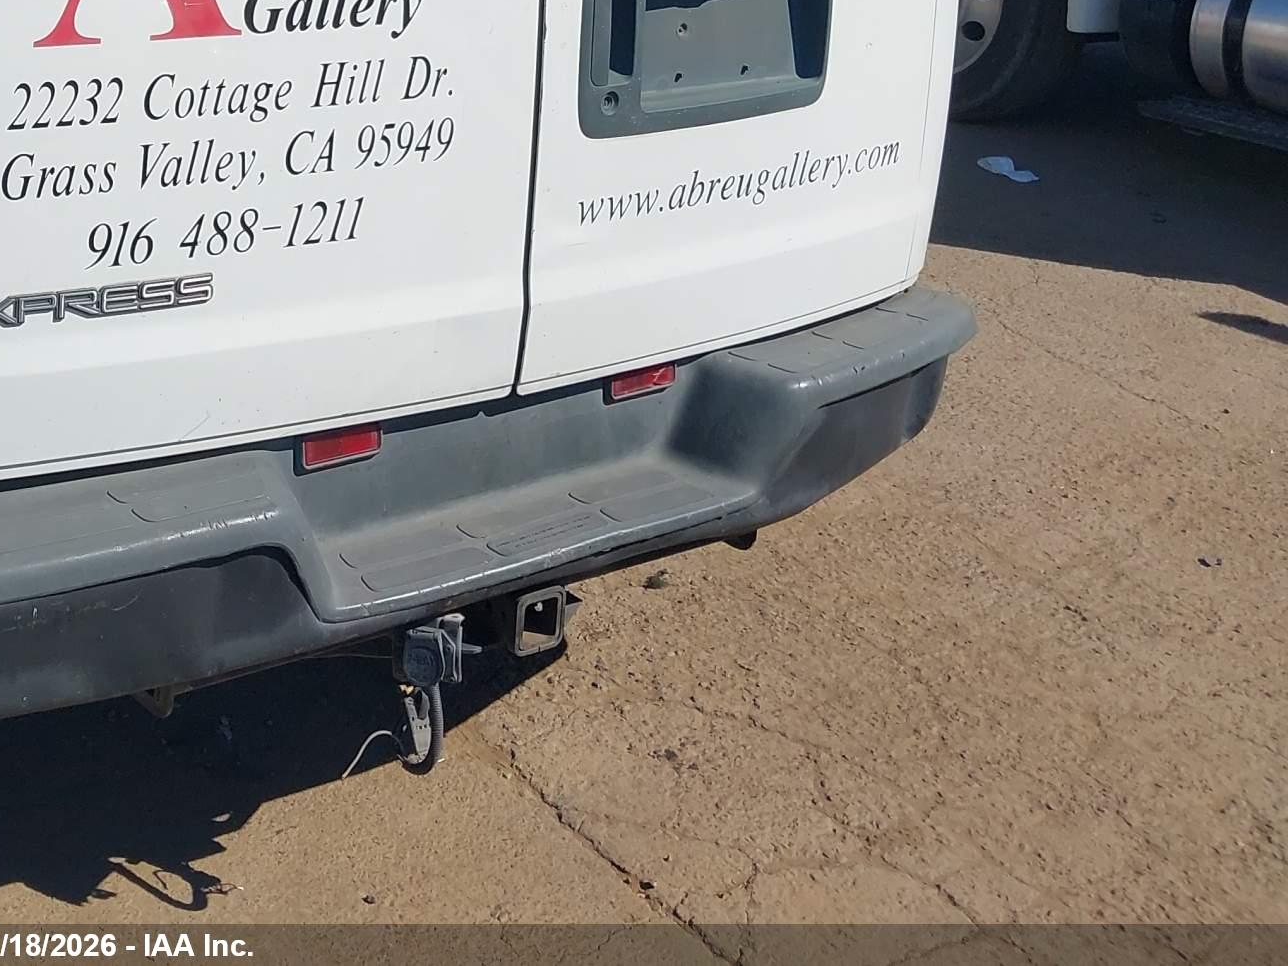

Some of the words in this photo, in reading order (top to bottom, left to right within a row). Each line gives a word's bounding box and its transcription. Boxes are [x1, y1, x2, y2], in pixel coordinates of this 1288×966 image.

[8, 77, 124, 131] 22232
[143, 73, 293, 122] Cottage
[311, 58, 384, 108] Hill
[402, 55, 454, 101] Dr.
[1, 153, 117, 201] Grass
[139, 139, 266, 192] Valley,
[285, 129, 336, 176] CA
[354, 117, 454, 169] 95949
[578, 140, 900, 226] www.abreugallery.com
[84, 216, 158, 270] 916
[179, 196, 364, 259] 488-1211
